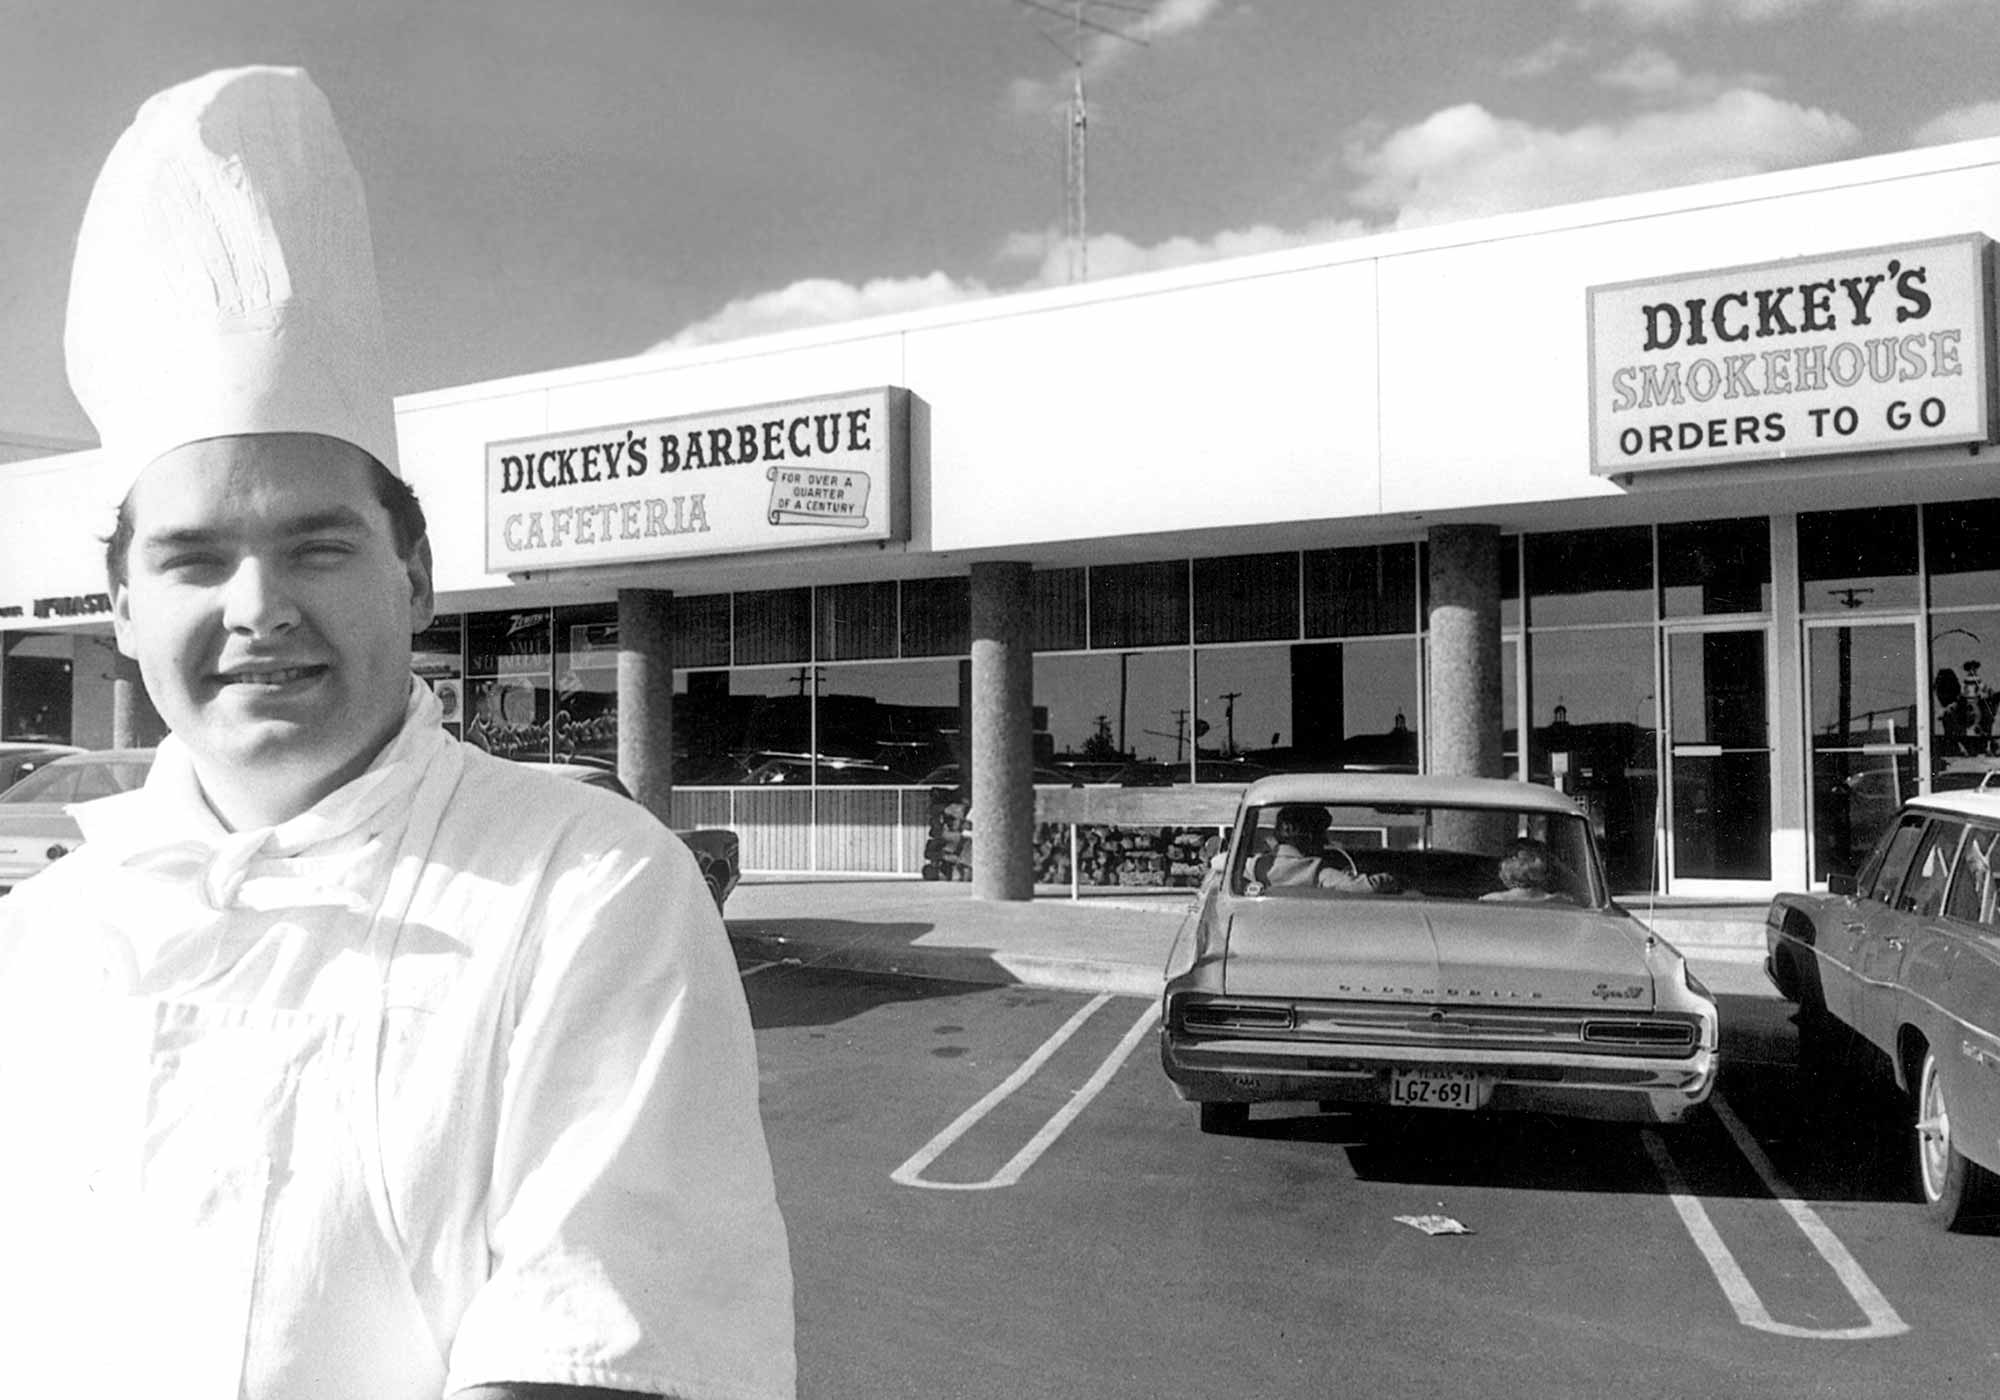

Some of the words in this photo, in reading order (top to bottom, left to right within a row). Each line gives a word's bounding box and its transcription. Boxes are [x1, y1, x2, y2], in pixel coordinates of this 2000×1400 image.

[1643, 259, 1932, 352] DICKEY'S
[1611, 328, 1962, 413] SMOKEHOUSE
[501, 430, 648, 493] DICKEY'S
[661, 408, 872, 474] BARBECUE
[1620, 413, 1786, 456] ORDERS
[1808, 406, 1859, 438] TO
[1886, 397, 1946, 431] GO
[778, 499, 790, 510] OF
[794, 500, 802, 510] A
[806, 501, 855, 513] CENTURY
[782, 473, 801, 483] FOR
[808, 475, 838, 486] OVER
[844, 477, 852, 487] A
[793, 487, 844, 499] QUARTER
[503, 494, 710, 551] CAFETERIA
